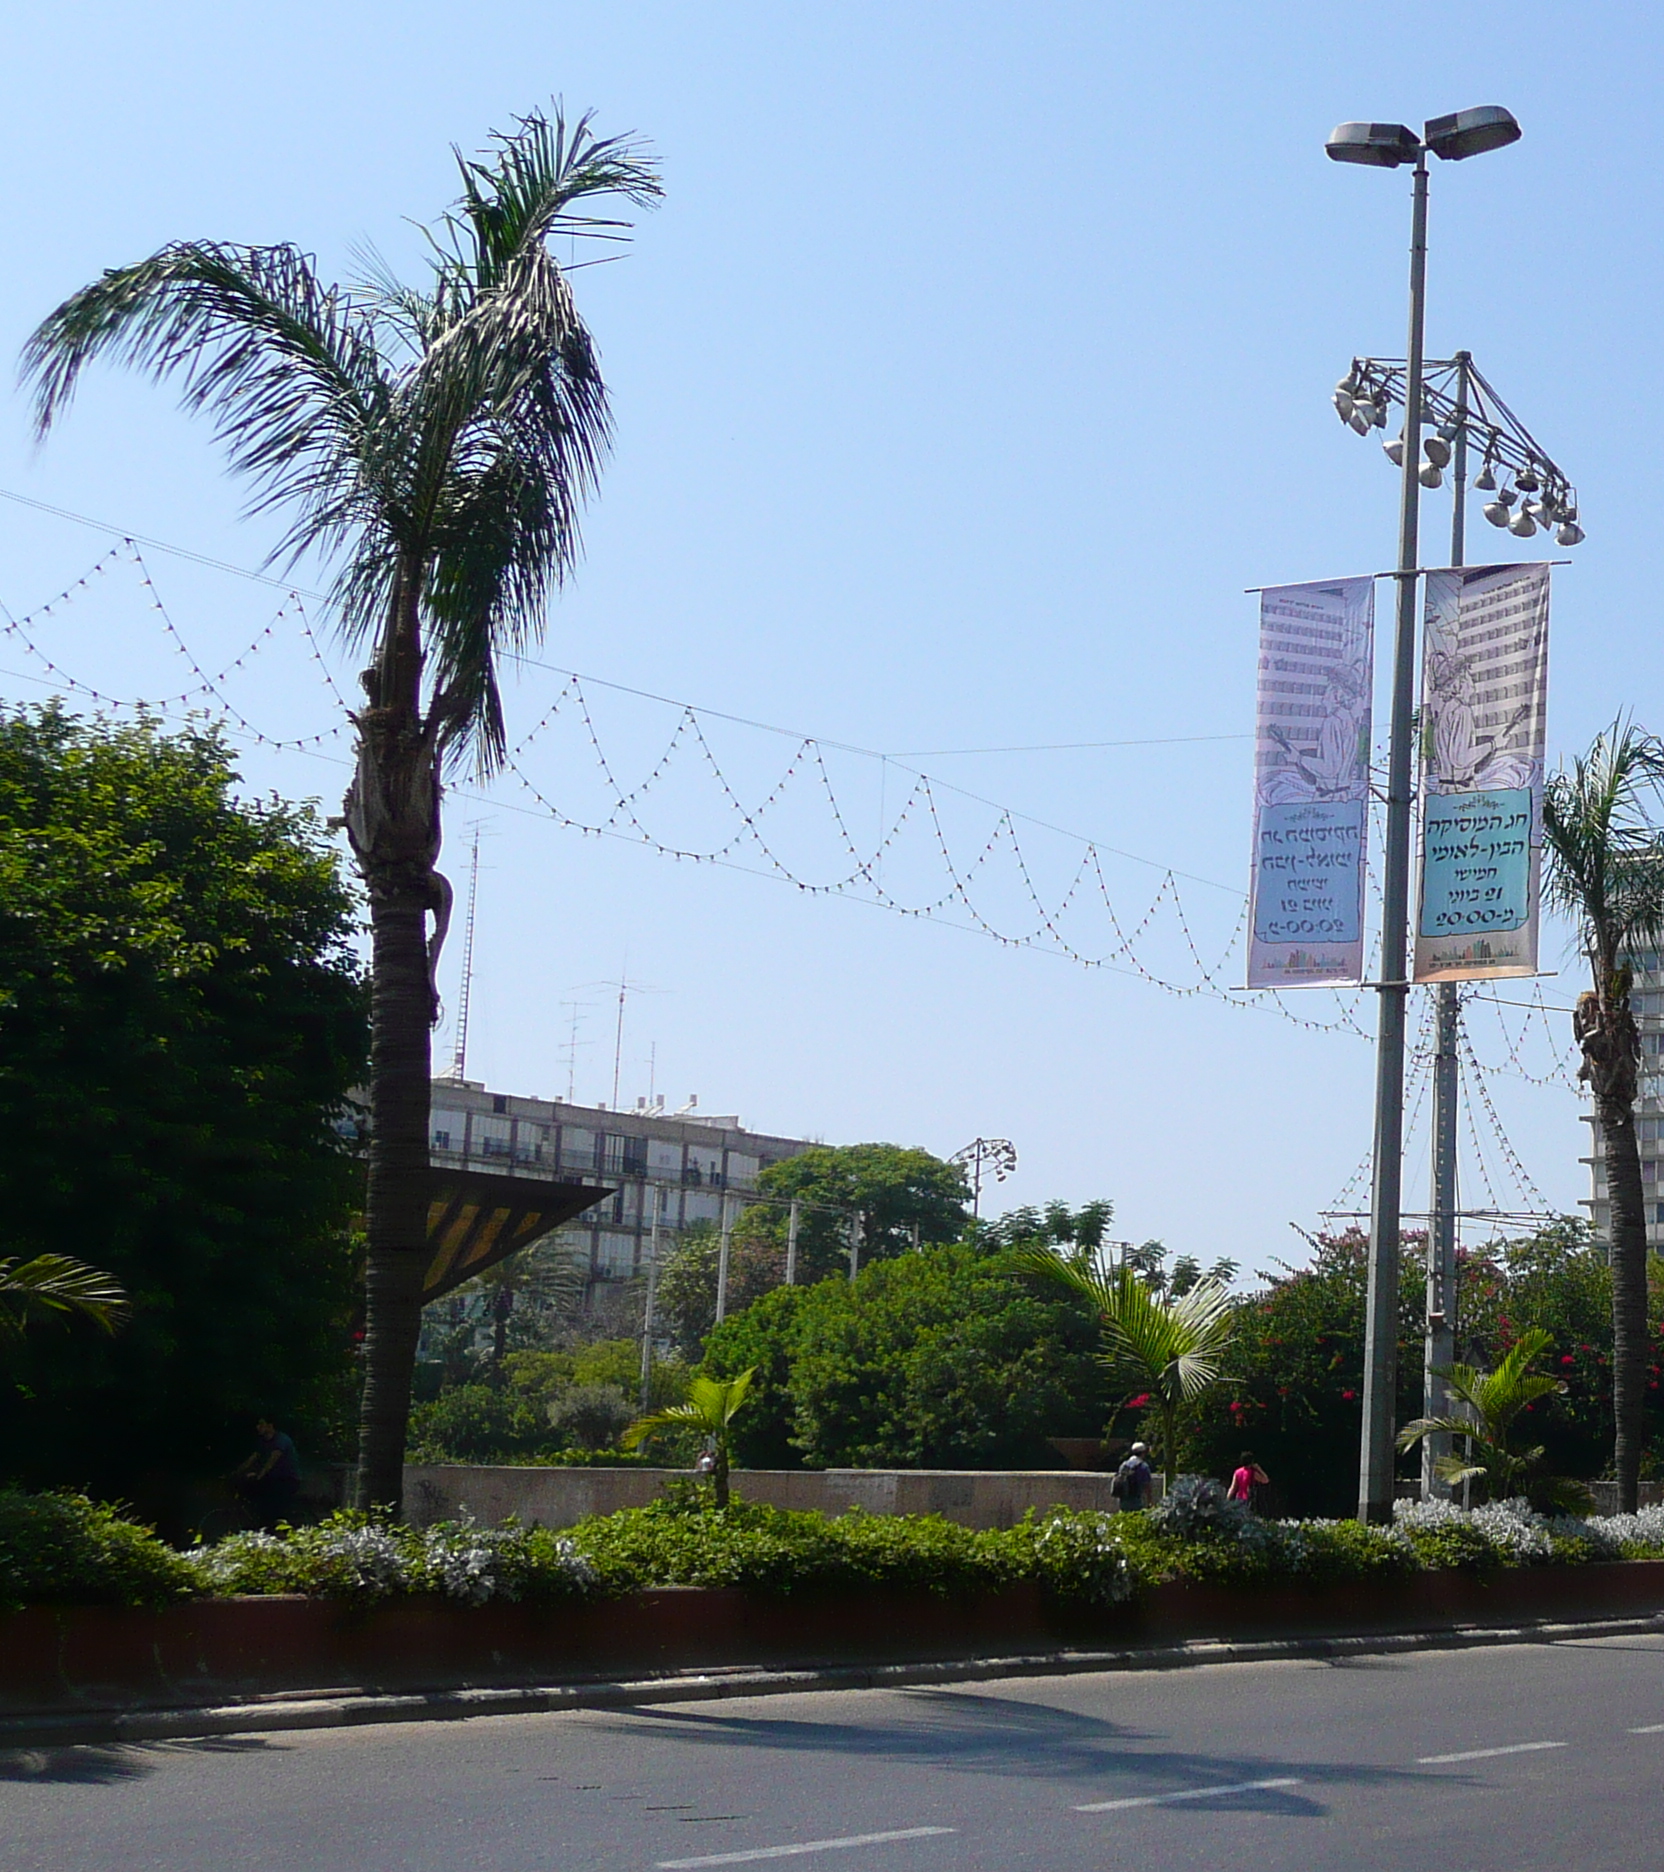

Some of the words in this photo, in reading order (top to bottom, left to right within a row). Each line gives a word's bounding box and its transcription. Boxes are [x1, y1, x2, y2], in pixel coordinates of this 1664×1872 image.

[1428, 816, 1502, 839] המוסיקה
[1505, 813, 1528, 829] חג
[1432, 835, 1525, 862] הבין-לאומי
[1455, 867, 1497, 881] חמישי
[1448, 889, 1480, 904] ביוני
[1485, 887, 1503, 901] 21
